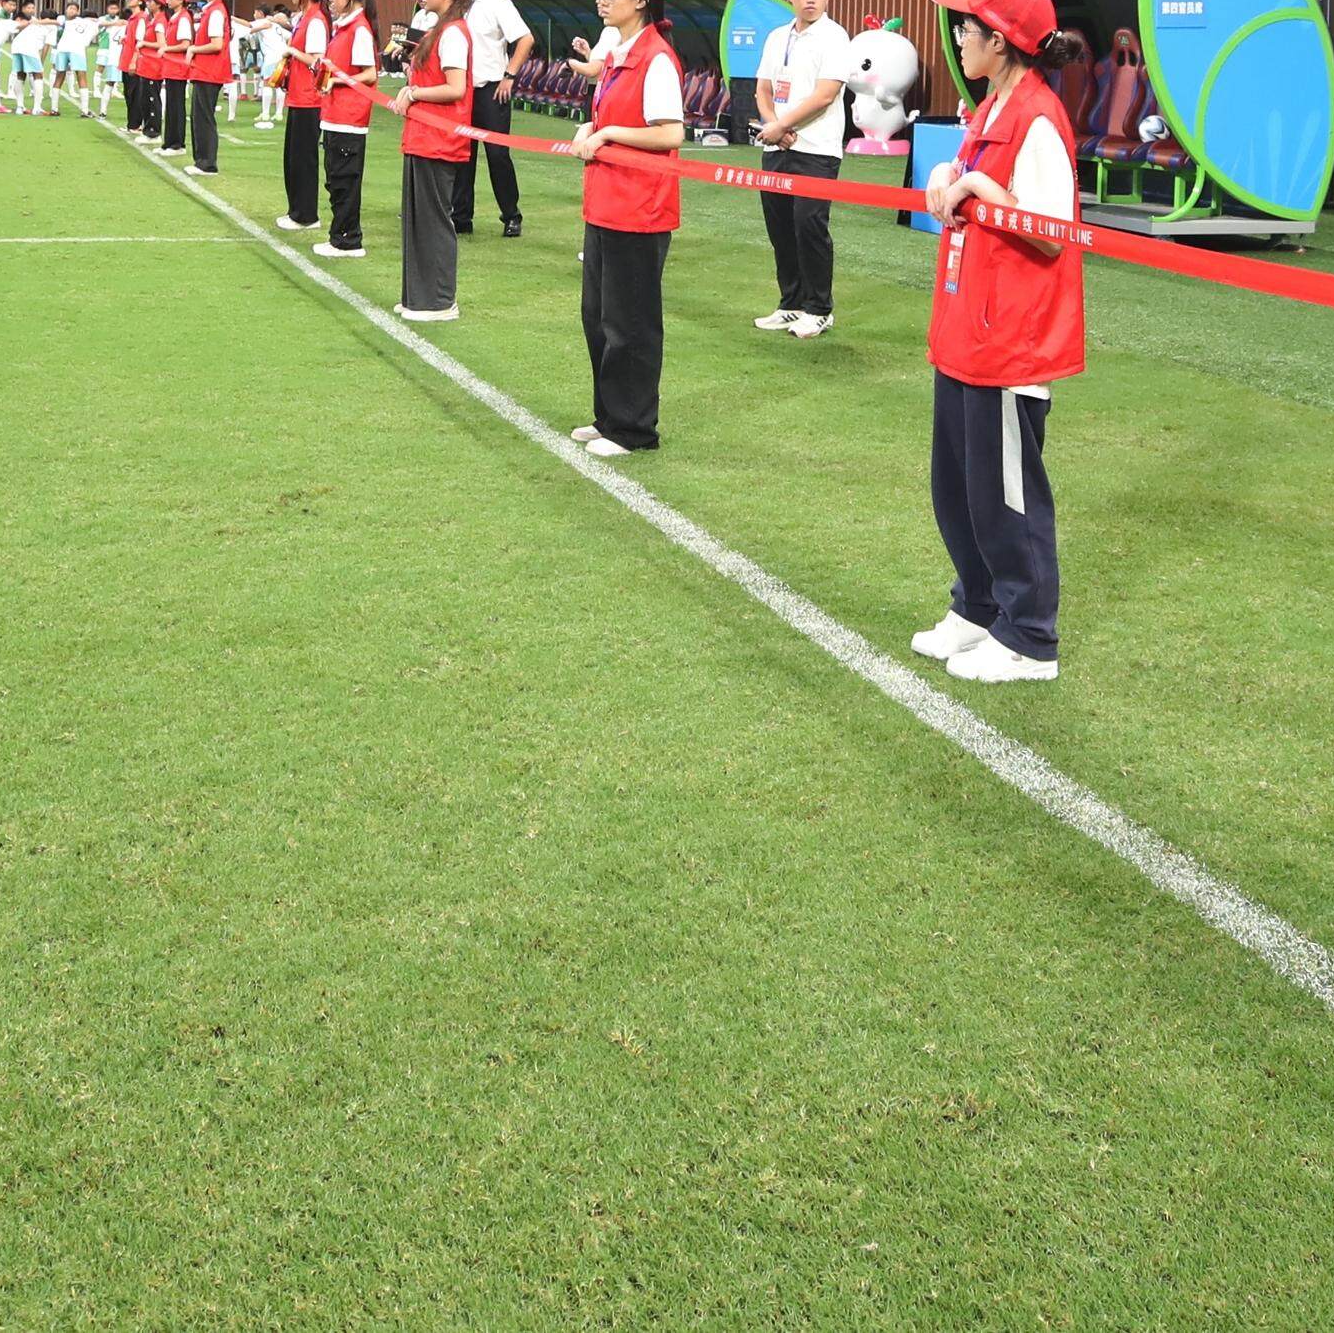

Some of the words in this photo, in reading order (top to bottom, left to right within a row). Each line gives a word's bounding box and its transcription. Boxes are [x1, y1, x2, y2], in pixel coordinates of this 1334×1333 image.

[756, 174, 775, 187] LIMIT
[776, 177, 793, 191] LINE
[993, 207, 1033, 234] 警戒线
[1038, 219, 1067, 239] LIMIT
[1069, 227, 1093, 246] LINE
